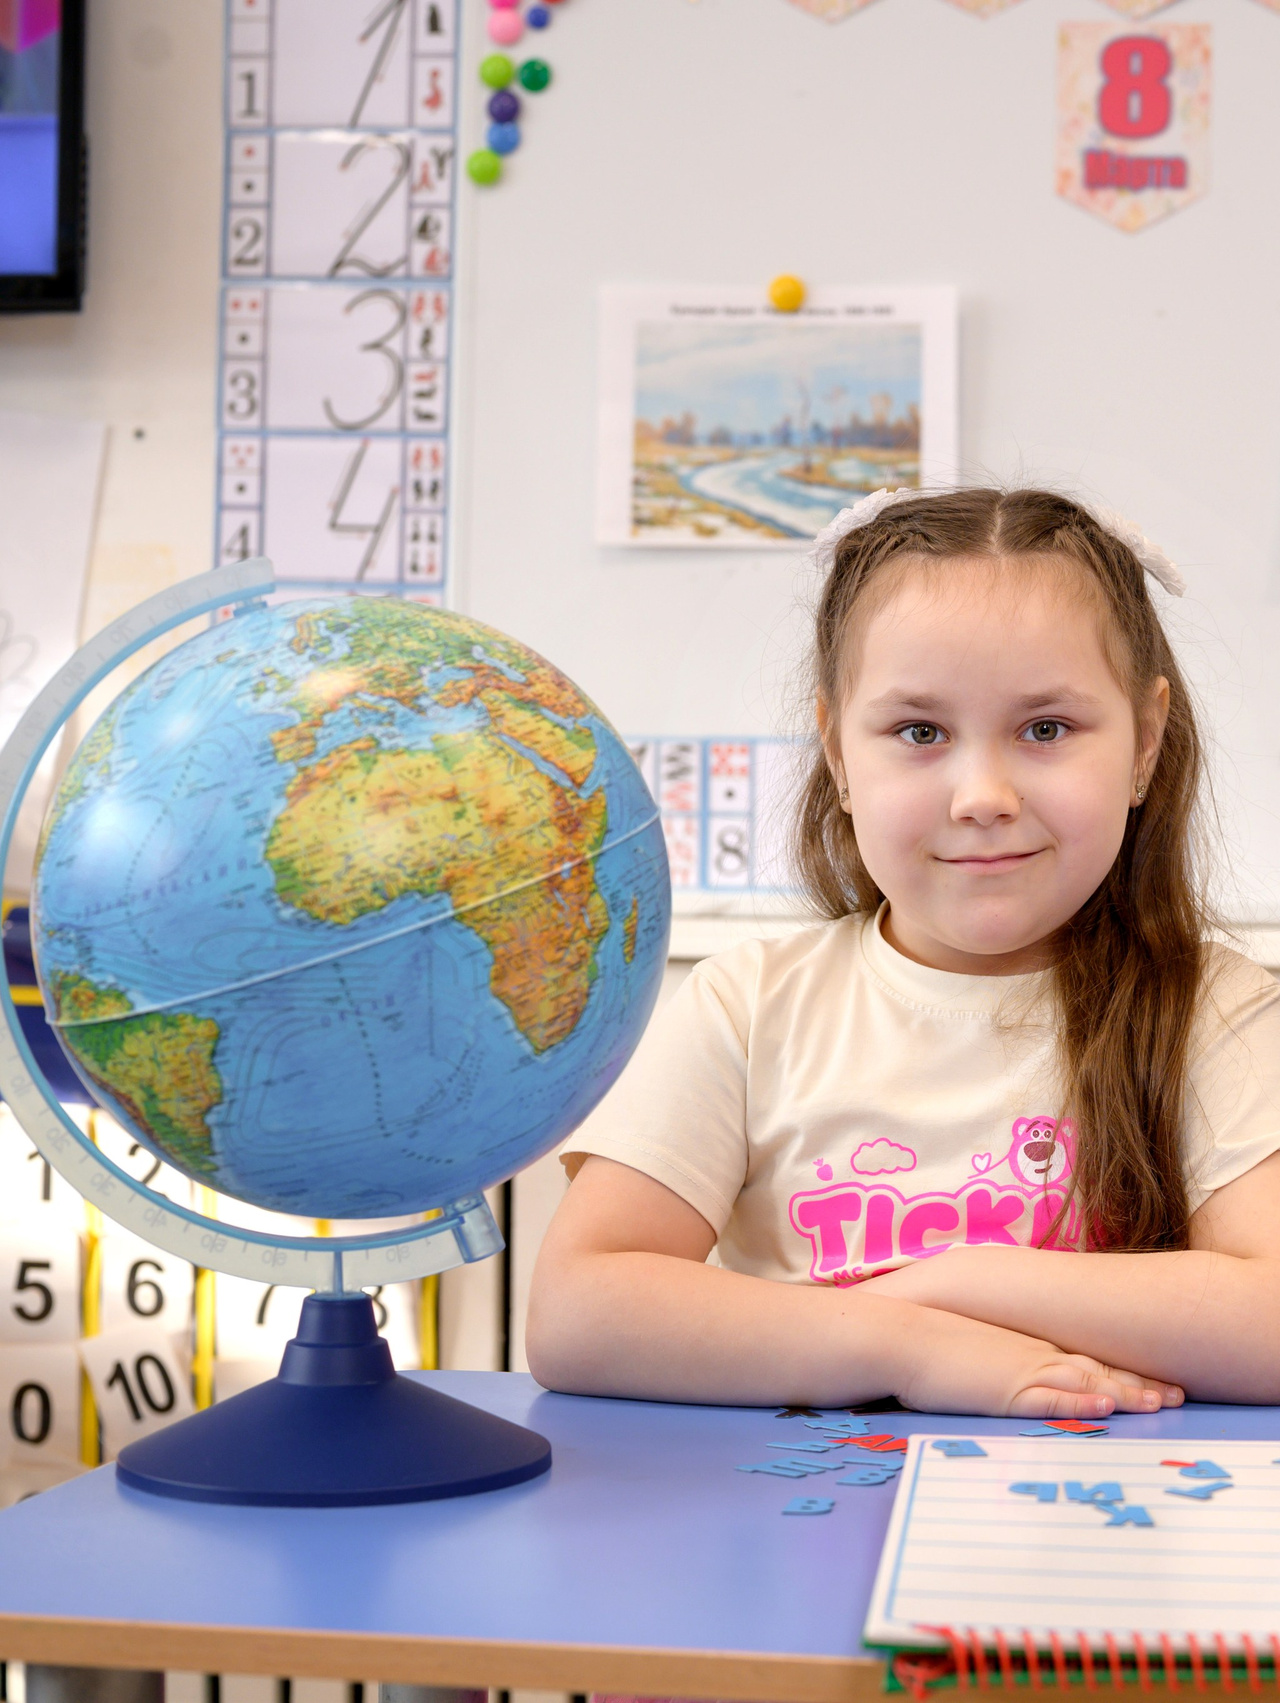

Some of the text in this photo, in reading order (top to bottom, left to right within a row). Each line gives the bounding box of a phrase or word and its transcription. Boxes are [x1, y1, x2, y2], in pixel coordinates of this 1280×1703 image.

[239, 71, 261, 118] 1
[1096, 34, 1174, 140] 8
[326, 134, 411, 278] 2
[232, 217, 264, 267] 2
[322, 288, 407, 430] 3
[227, 369, 258, 420] 3
[328, 438, 400, 582] 4
[714, 825, 748, 877] 8
[14, 1261, 54, 1323] 5
[127, 1260, 164, 1318] 6
[12, 1383, 52, 1445] 0
[106, 1354, 176, 1422] 10
